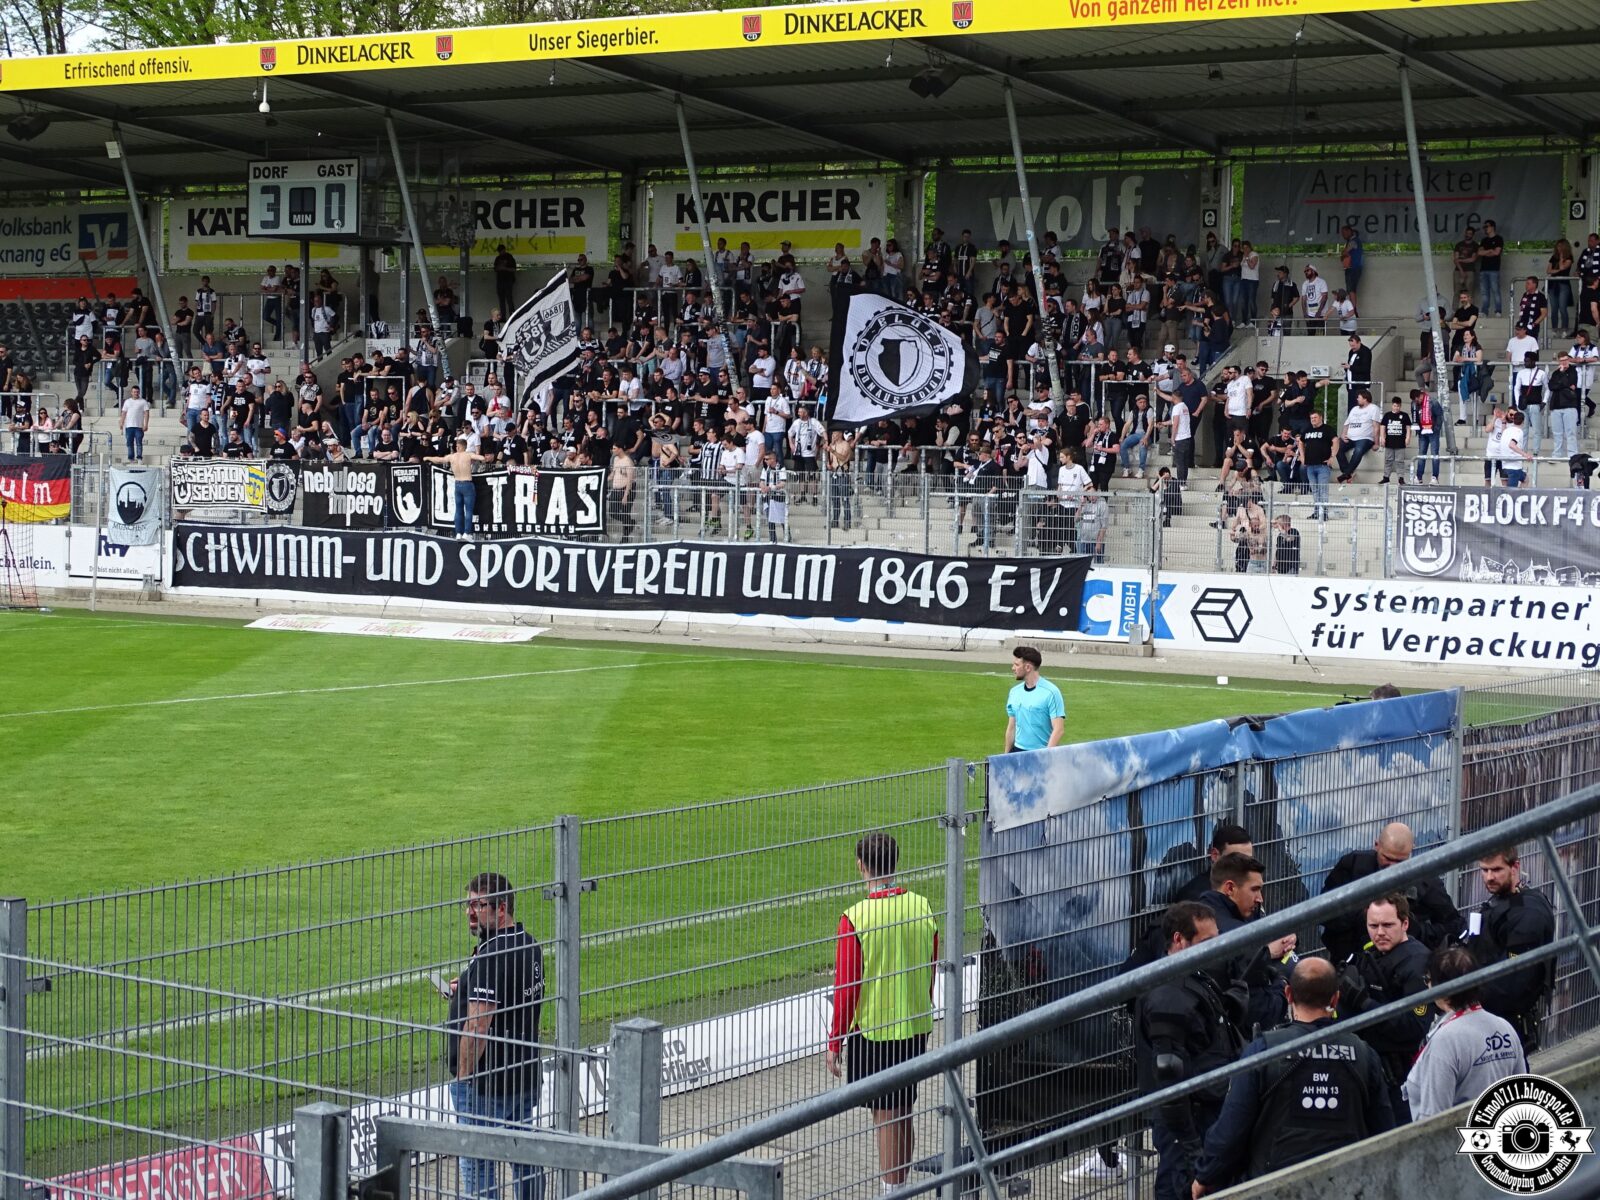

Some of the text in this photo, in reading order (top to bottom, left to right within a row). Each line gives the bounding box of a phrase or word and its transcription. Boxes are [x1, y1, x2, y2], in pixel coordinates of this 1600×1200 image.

[1107, 0, 1178, 21] ganzem
[784, 8, 928, 36] DINKELACKER
[529, 27, 659, 51] Unser Siegerbier.
[297, 42, 415, 65] DINKELACKER
[64, 57, 193, 79] Erfrischend offensiv.
[253, 164, 354, 178] DORF GAST
[1310, 166, 1493, 194] Architekten
[676, 188, 861, 224] KÄRCHER
[989, 176, 1144, 242] wolf
[293, 214, 312, 224] MIN
[50, 243, 71, 262] eG
[433, 475, 600, 526] UTRAS
[1405, 494, 1454, 504] FUSSBALL
[1463, 493, 1548, 526] BLOCK
[1552, 495, 1584, 526] F4
[1405, 503, 1453, 520] SSV
[1405, 520, 1453, 537] 1846
[858, 556, 969, 609] 1846
[1310, 586, 1591, 622] Systempartner
[1311, 622, 1600, 669] für Verpackung
[1485, 1033, 1512, 1051] SDS
[1312, 1073, 1329, 1082] BW
[1302, 1086, 1340, 1095] AH HN 13
